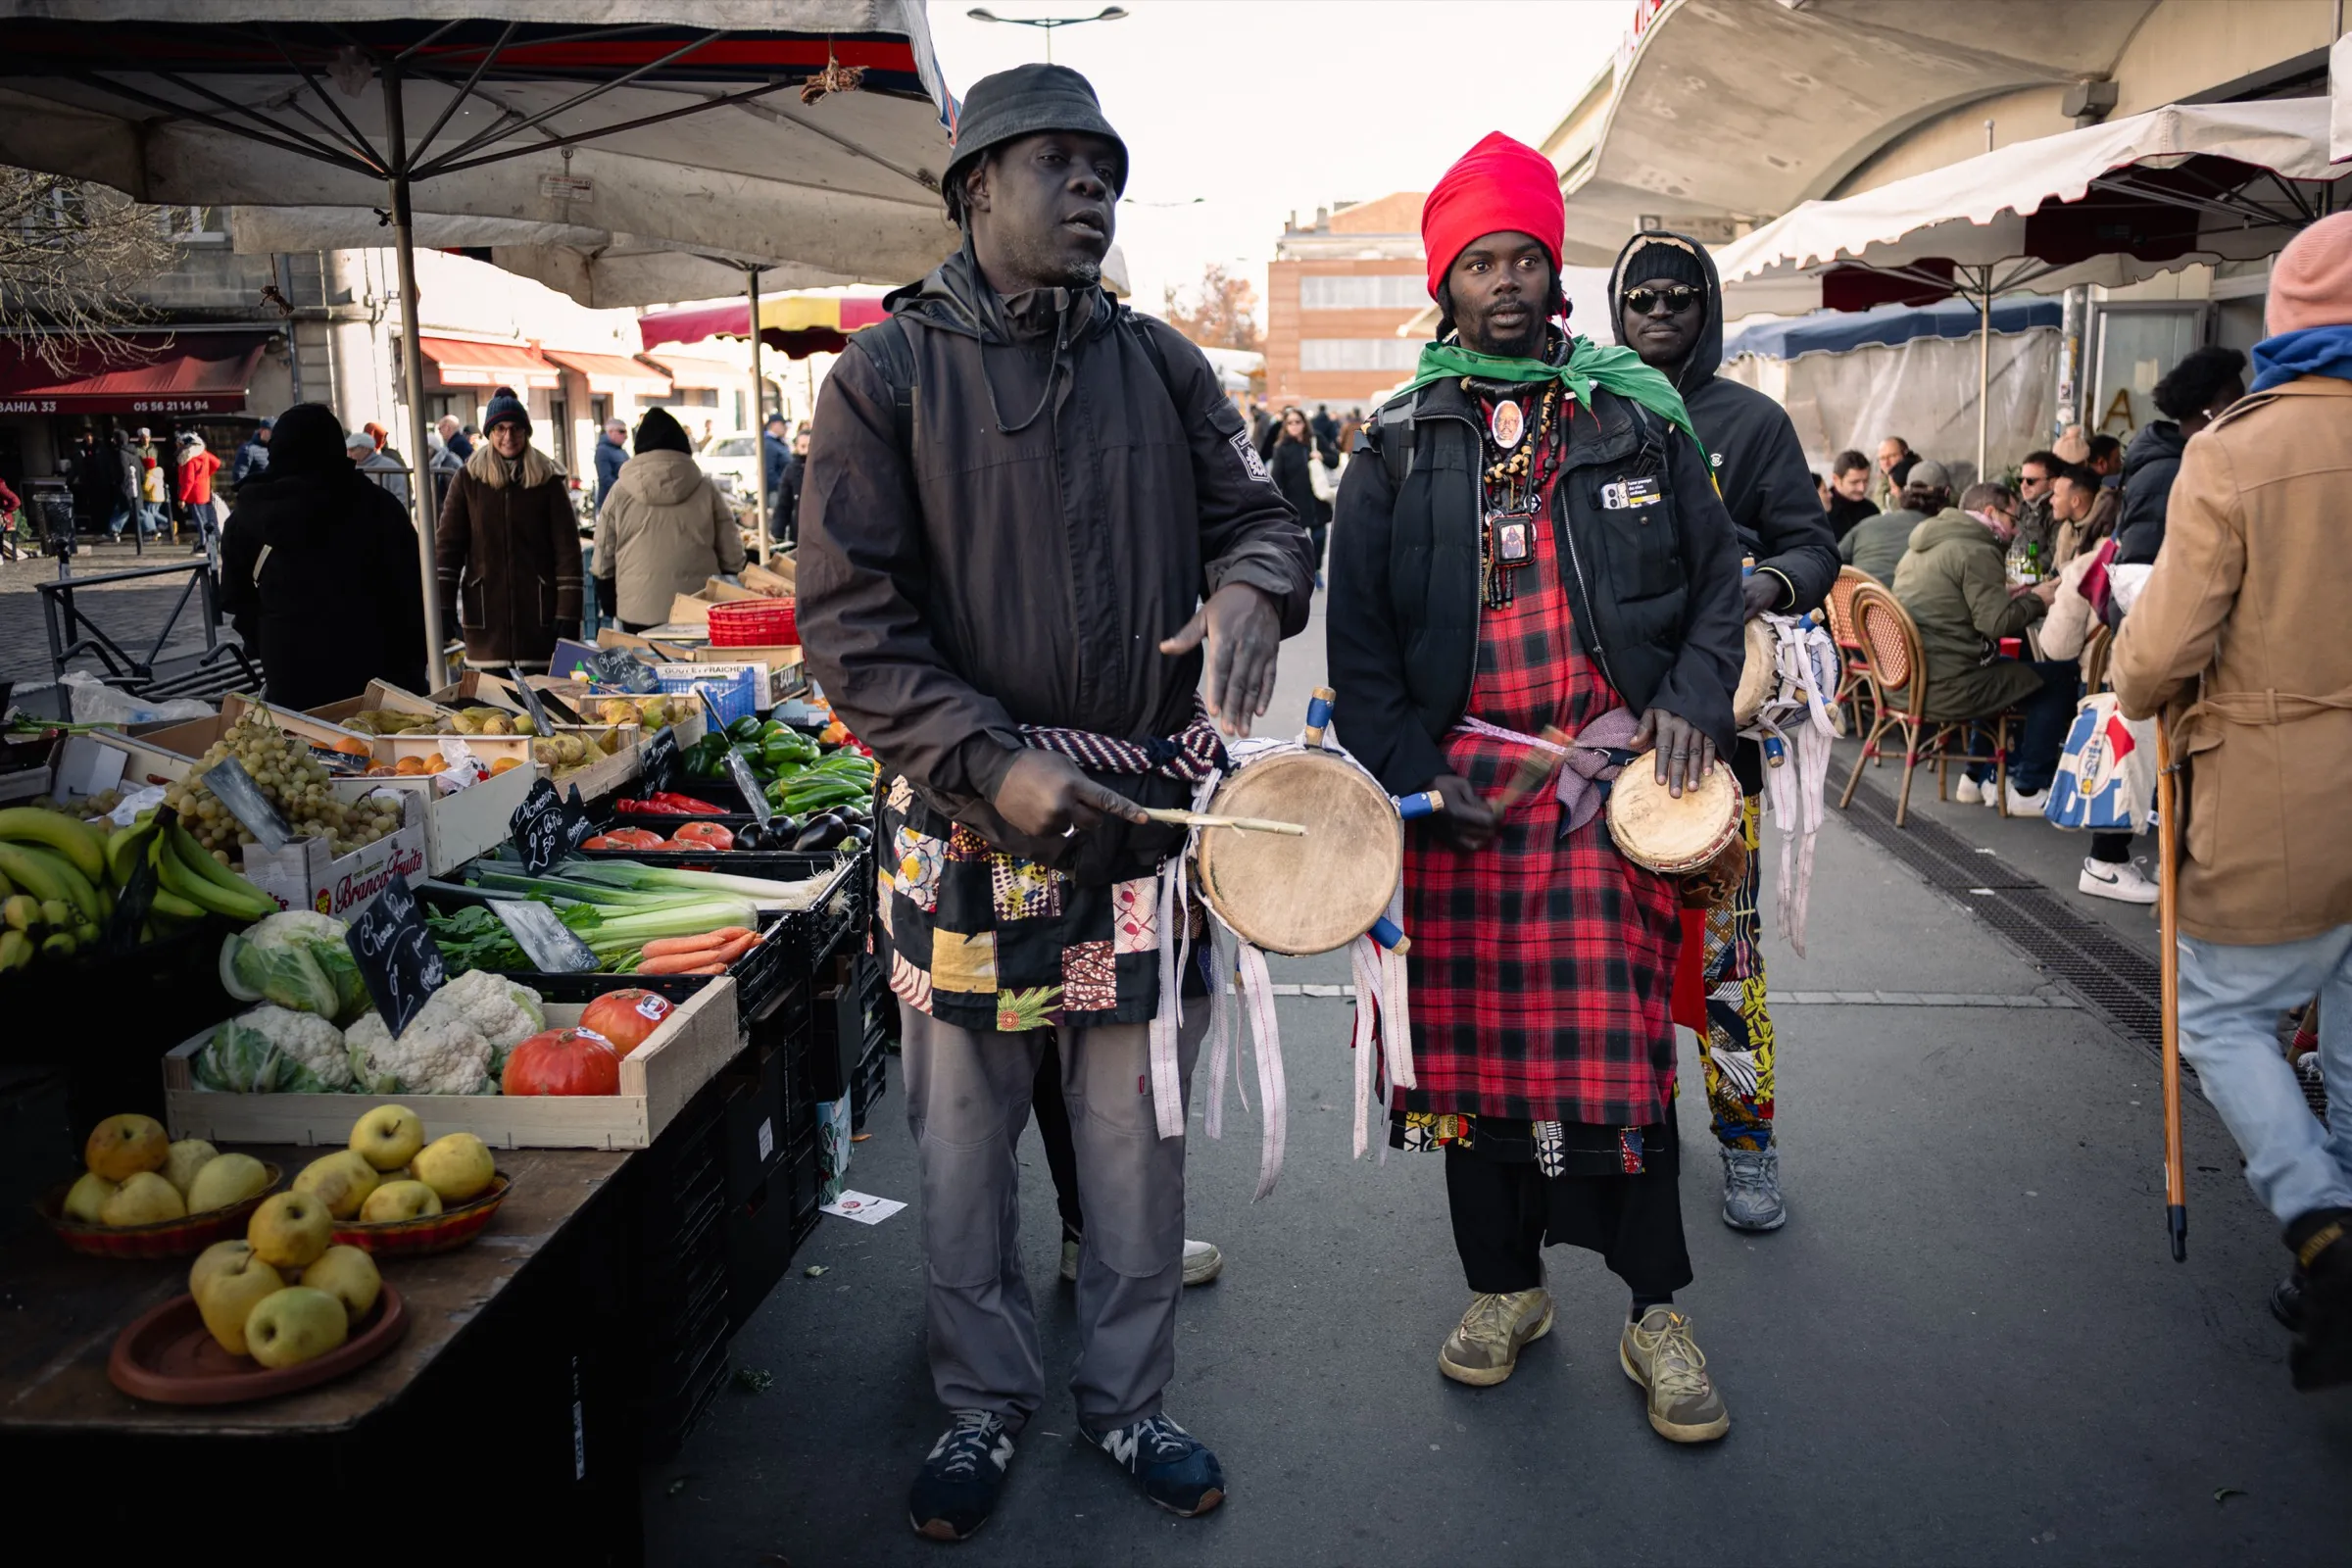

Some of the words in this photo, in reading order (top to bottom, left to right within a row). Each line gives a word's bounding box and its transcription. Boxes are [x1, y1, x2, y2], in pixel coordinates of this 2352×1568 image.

[41, 401, 57, 413] 33
[133, 402, 148, 412] 05
[150, 402, 164, 412] 56
[166, 401, 178, 412] 21
[179, 401, 192, 411] 14
[194, 401, 209, 411] 94
